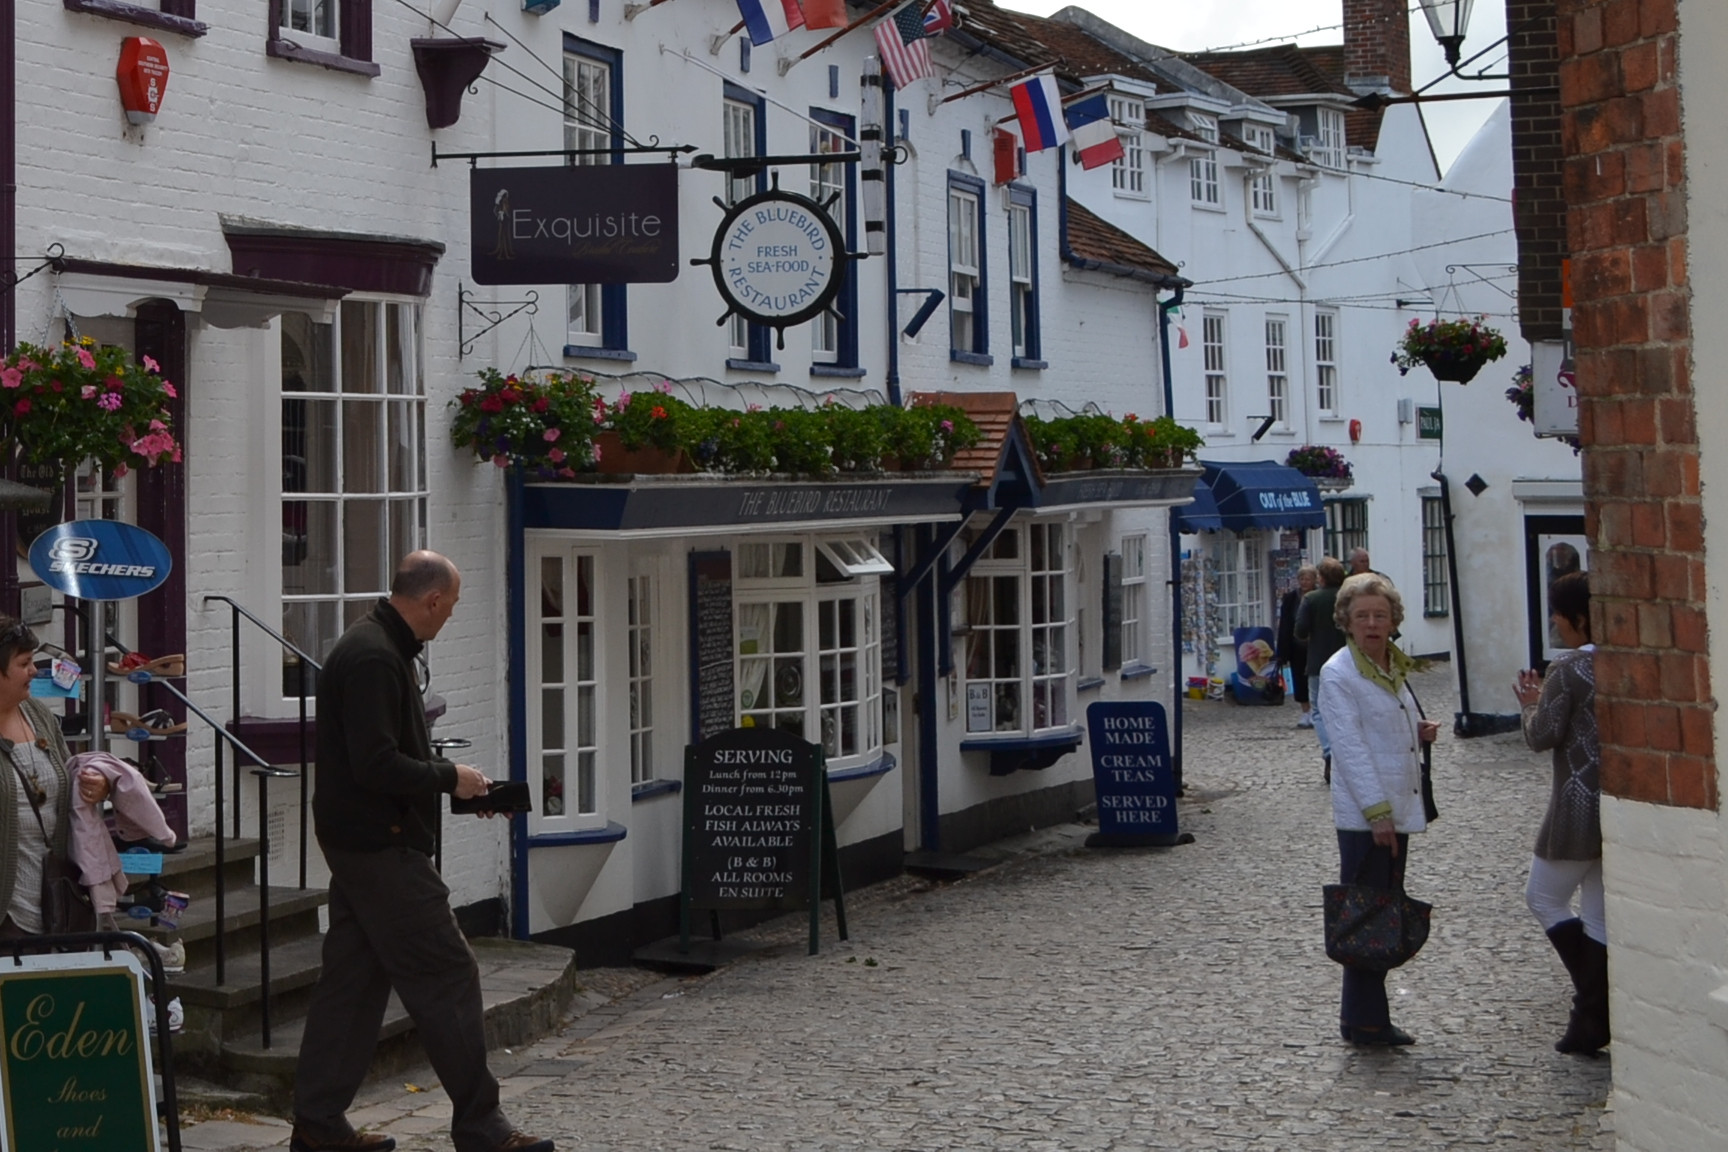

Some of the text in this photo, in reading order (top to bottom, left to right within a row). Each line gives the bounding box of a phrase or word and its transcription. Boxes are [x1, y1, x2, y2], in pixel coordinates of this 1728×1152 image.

[512, 209, 662, 246] Exquisite
[728, 207, 825, 251] THE BLUEBIRD
[756, 244, 798, 258] FRESH
[747, 259, 810, 274] SEA-FOOD
[728, 265, 825, 310] RESTAURANT
[738, 488, 893, 516] THE BLUEBIRD RESTAURANT
[1259, 491, 1277, 508] OUT
[1290, 491, 1312, 508] BLUE
[48, 560, 156, 578] SKECHERS
[1103, 717, 1156, 730] HOME
[1105, 732, 1156, 745] MADE
[713, 749, 793, 764] SERVING
[1100, 755, 1162, 768] CREAM
[709, 769, 797, 782] Lunch from 12pm
[1111, 770, 1155, 782] TEAS
[702, 783, 804, 797] Dinner from 6.30pm
[1102, 795, 1168, 808] SERVED
[704, 804, 801, 816] LOCAL FRESH
[1115, 810, 1162, 823] HERE
[705, 820, 801, 831] FISH ALWAYS
[711, 835, 793, 847] AVAILABLE
[745, 856, 759, 868] &
[711, 871, 793, 883] ALL ROOMS
[719, 887, 784, 898] EN SUITE
[10, 993, 133, 1061] Eden
[47, 1074, 107, 1103] Shoes
[56, 1114, 103, 1138] and
